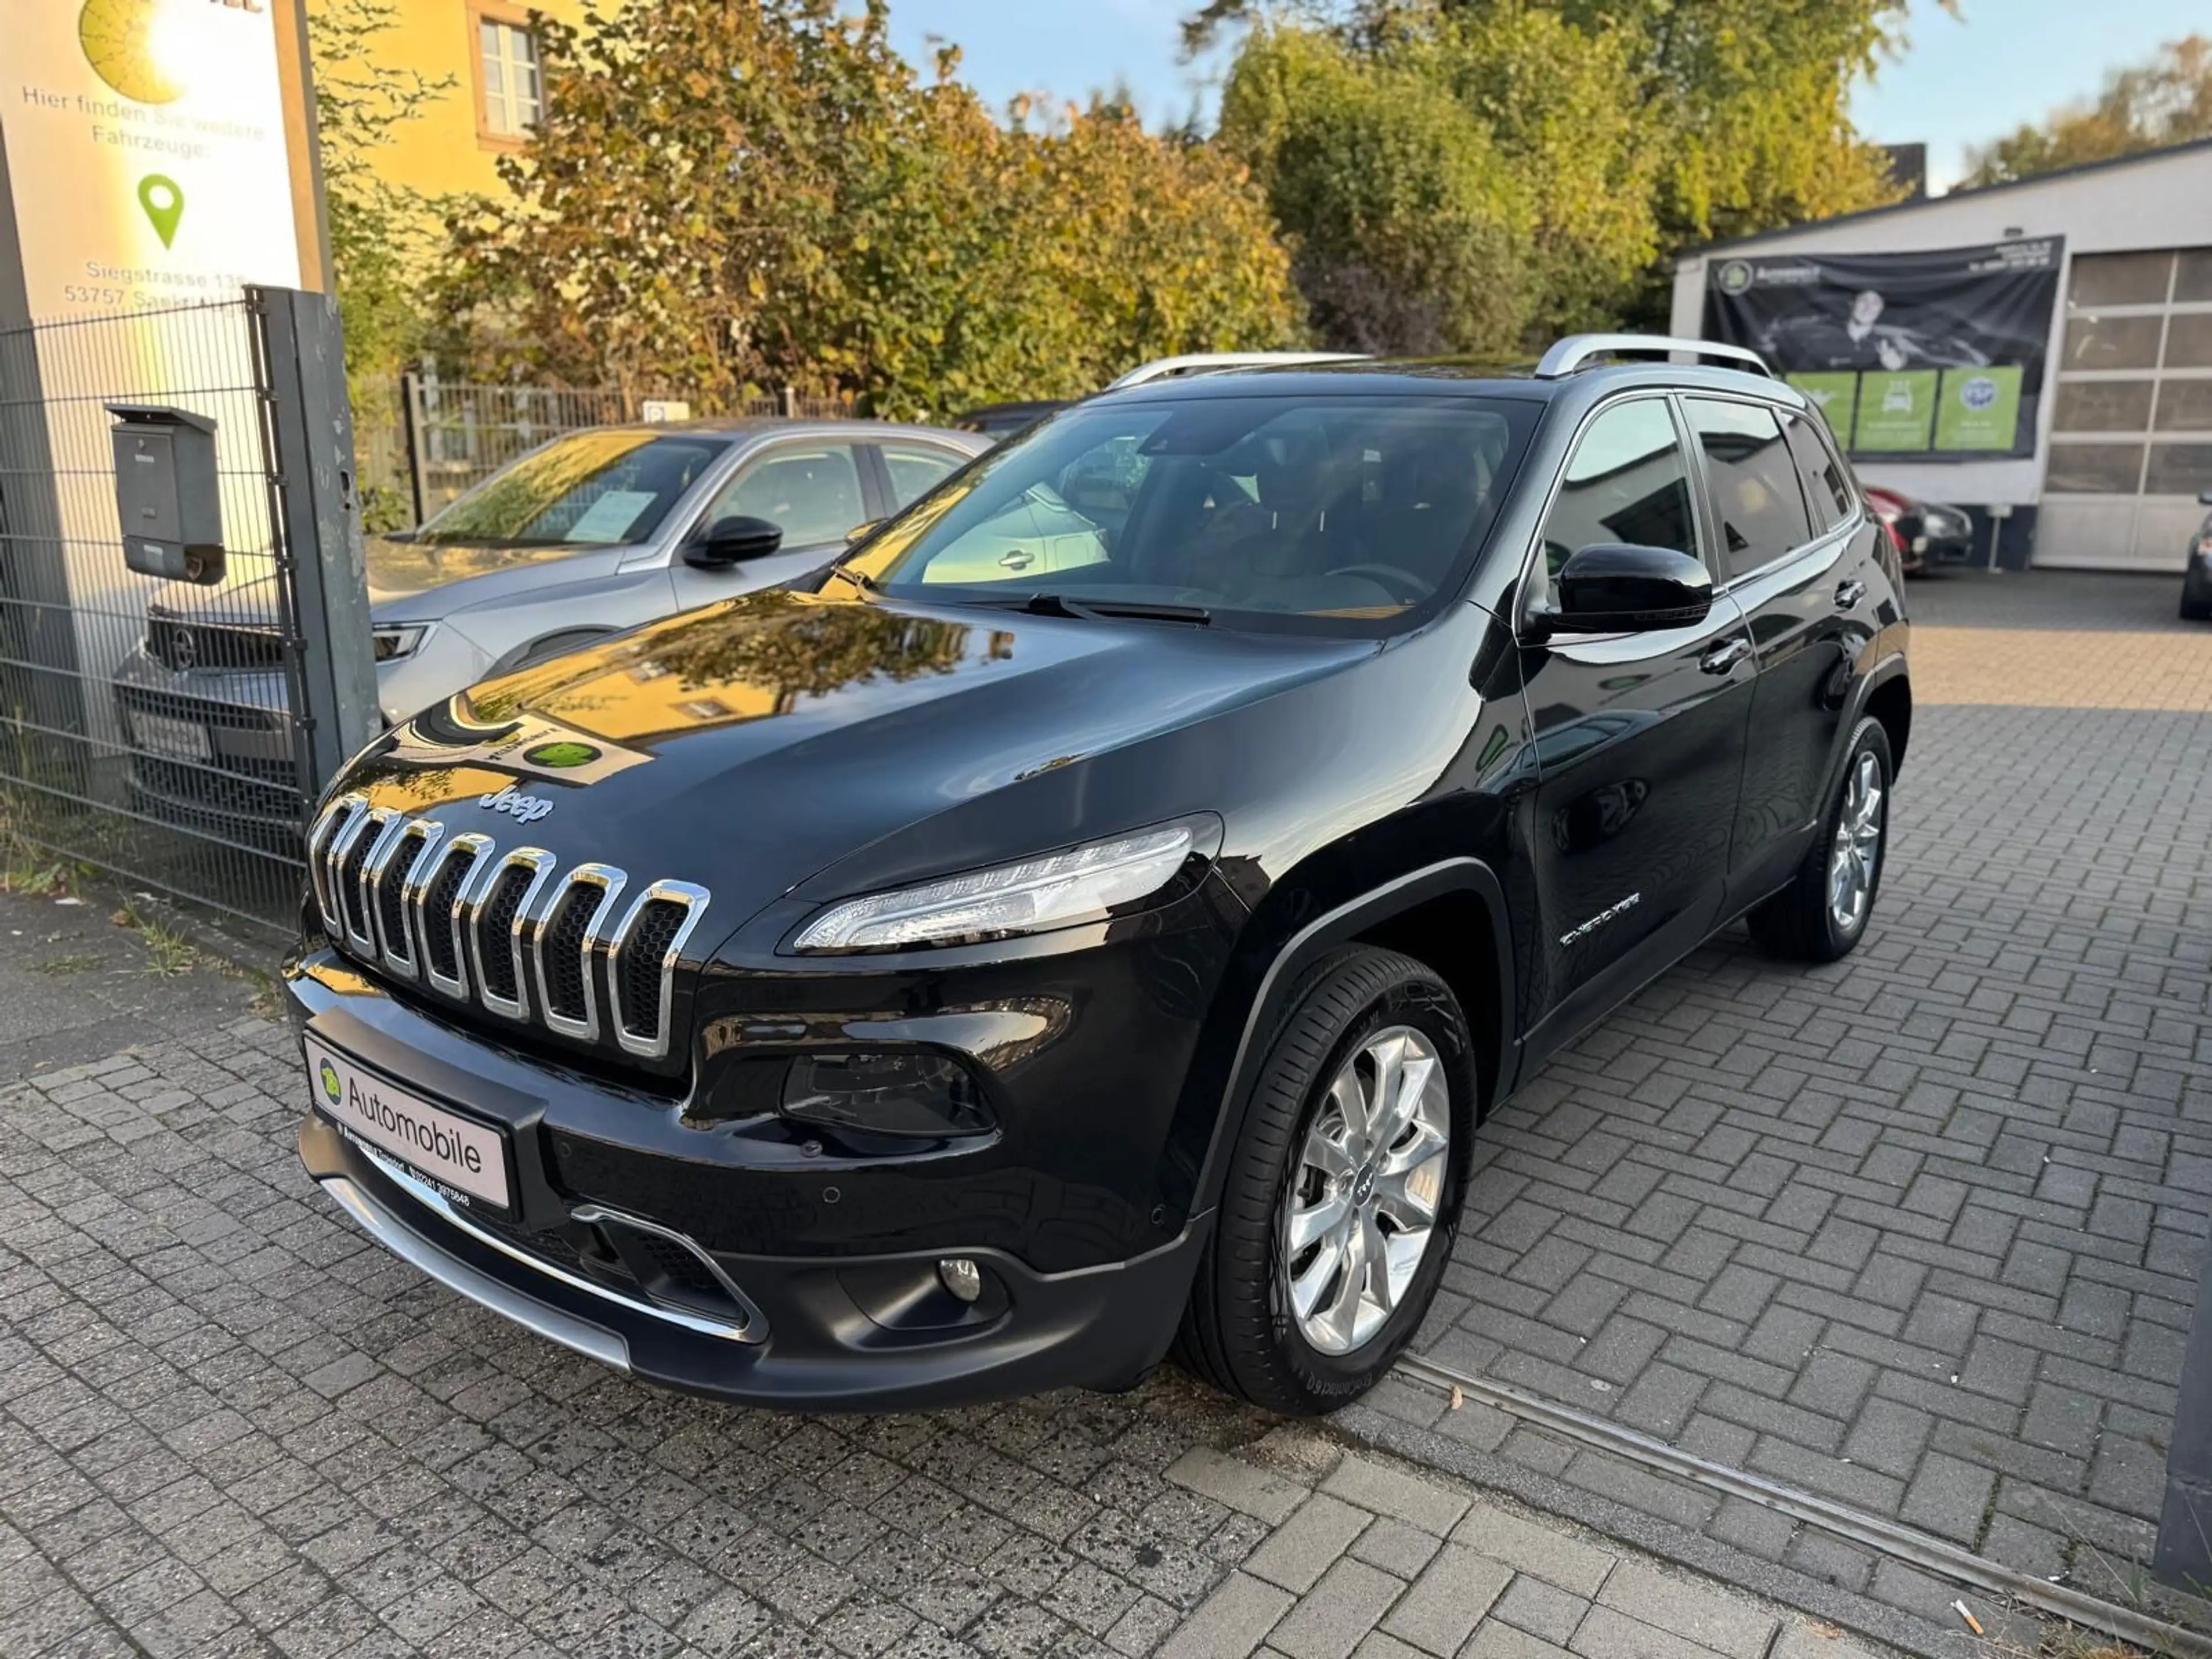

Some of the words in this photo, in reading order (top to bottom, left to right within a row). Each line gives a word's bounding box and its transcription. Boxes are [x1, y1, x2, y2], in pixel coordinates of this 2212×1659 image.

[22, 86, 69, 109] Hier
[77, 94, 146, 122] finden
[86, 261, 207, 287] Siegstrasse
[65, 285, 125, 305] 53757
[479, 785, 554, 825] Jeep
[349, 1076, 482, 1173] Automobile
